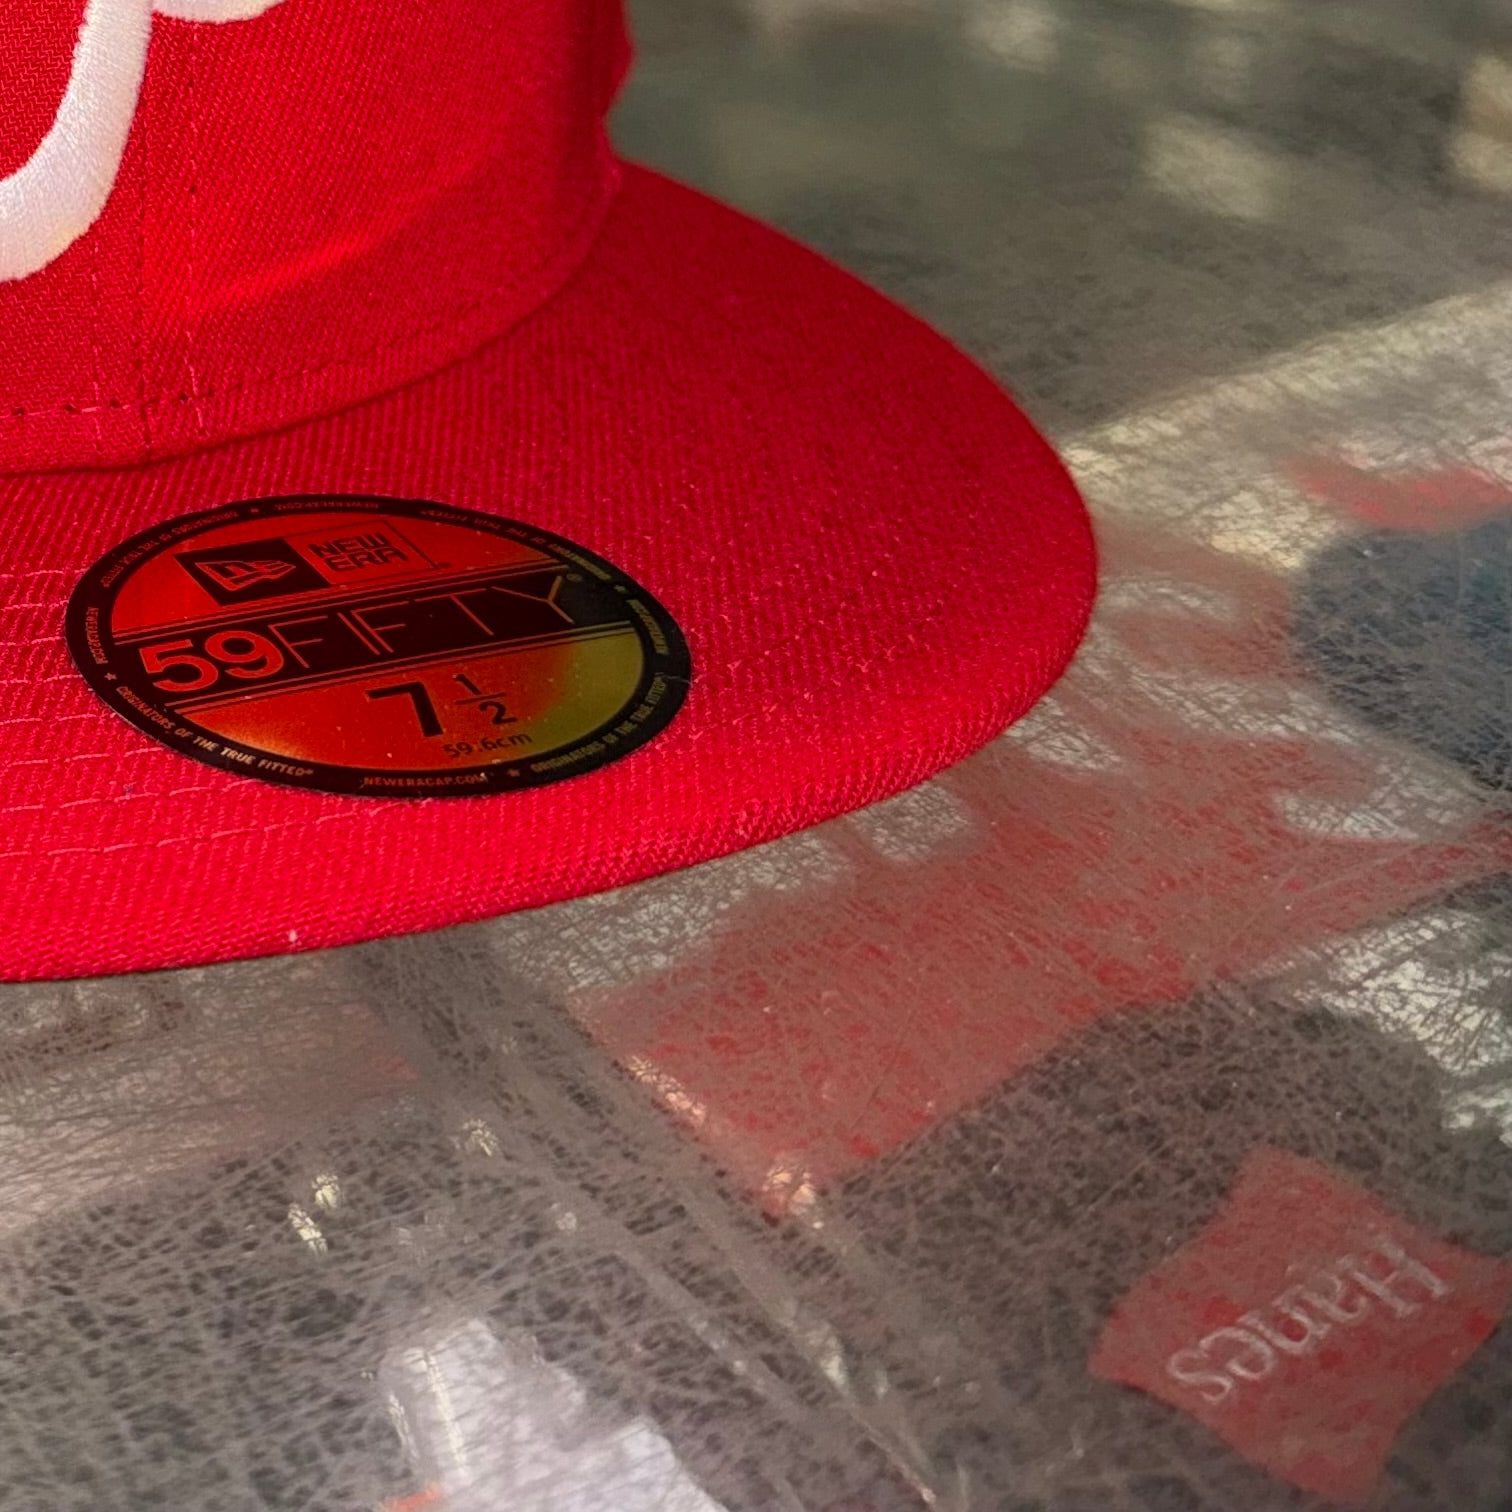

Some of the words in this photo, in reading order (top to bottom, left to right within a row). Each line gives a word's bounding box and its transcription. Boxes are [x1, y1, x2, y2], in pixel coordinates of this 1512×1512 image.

[307, 532, 391, 559] NEW
[323, 545, 410, 573] ERA
[137, 574, 576, 693] 59FIFTY
[364, 680, 445, 739] 7
[174, 727, 194, 739] OF
[192, 735, 221, 753] THE
[220, 746, 257, 767] TRUE
[1166, 1236, 1450, 1405] Hanes
